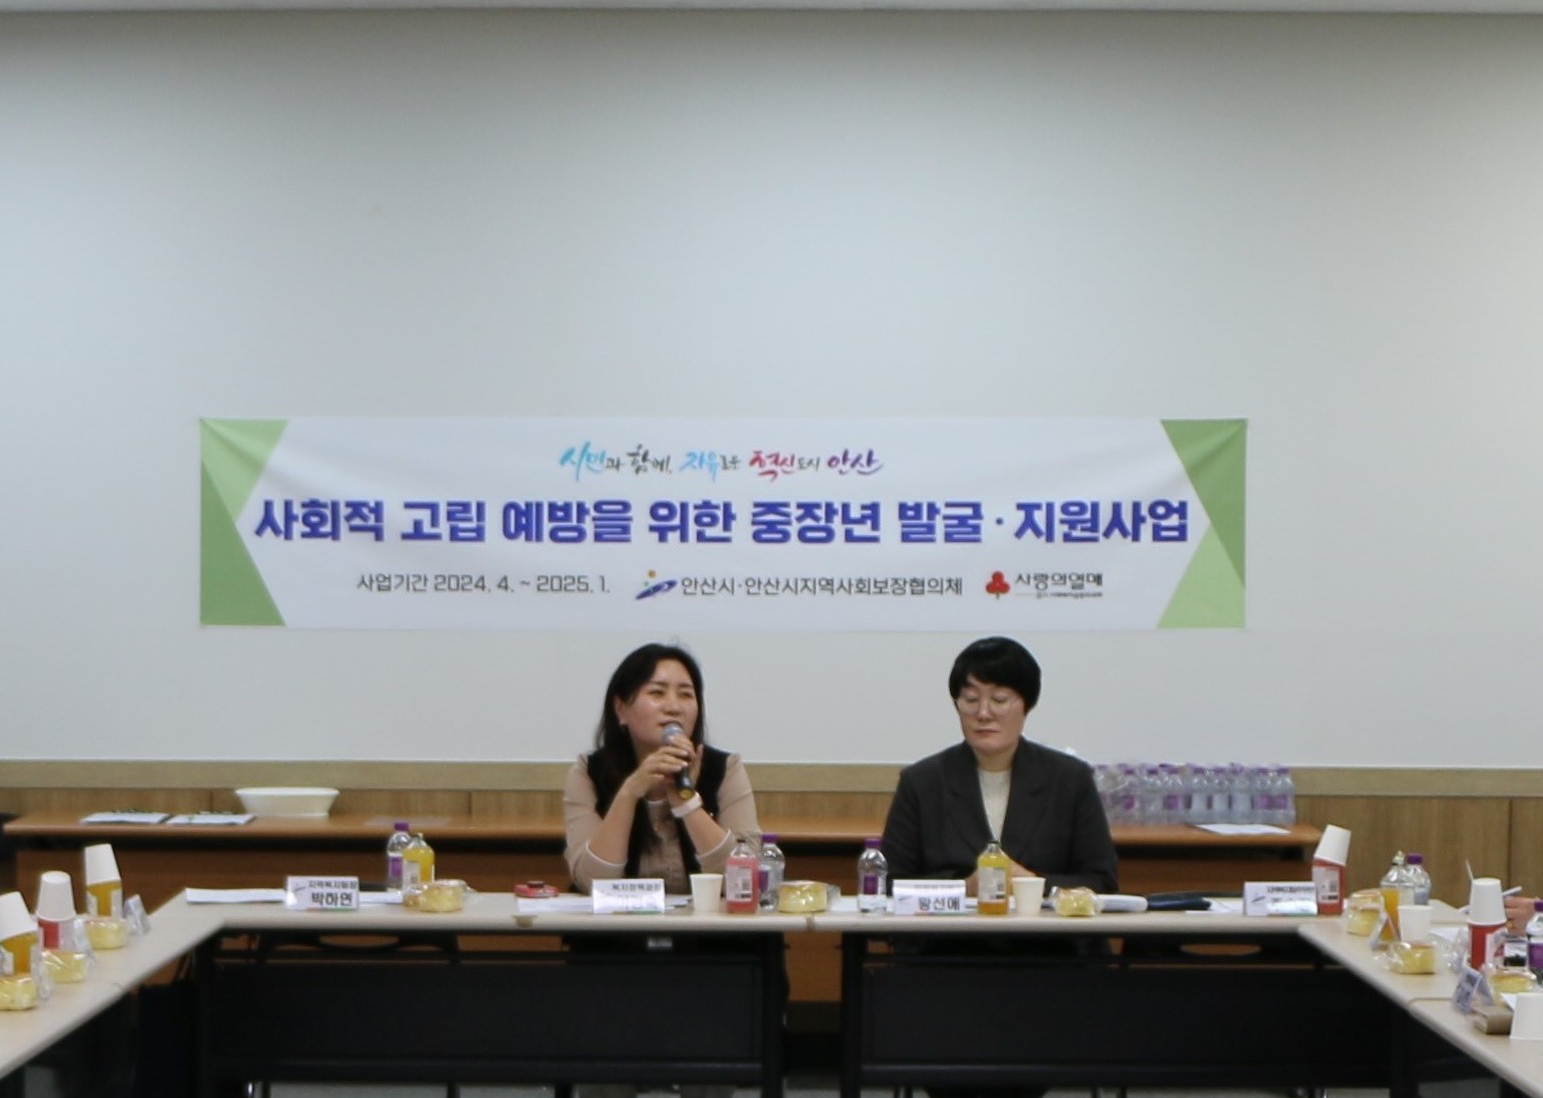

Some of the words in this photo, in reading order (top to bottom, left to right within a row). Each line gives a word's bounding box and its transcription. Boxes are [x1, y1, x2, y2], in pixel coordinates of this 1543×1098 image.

[826, 447, 884, 477] 안산
[254, 499, 385, 542] 사회적
[400, 500, 487, 542] 고립
[501, 500, 634, 543] 예방을
[648, 500, 736, 543] 위한
[750, 500, 882, 544] 중장년
[356, 574, 428, 594] 사업기간
[433, 575, 491, 594] 2024.
[496, 575, 515, 594] 4.
[536, 575, 595, 594] 2025.
[599, 575, 611, 594] 1.
